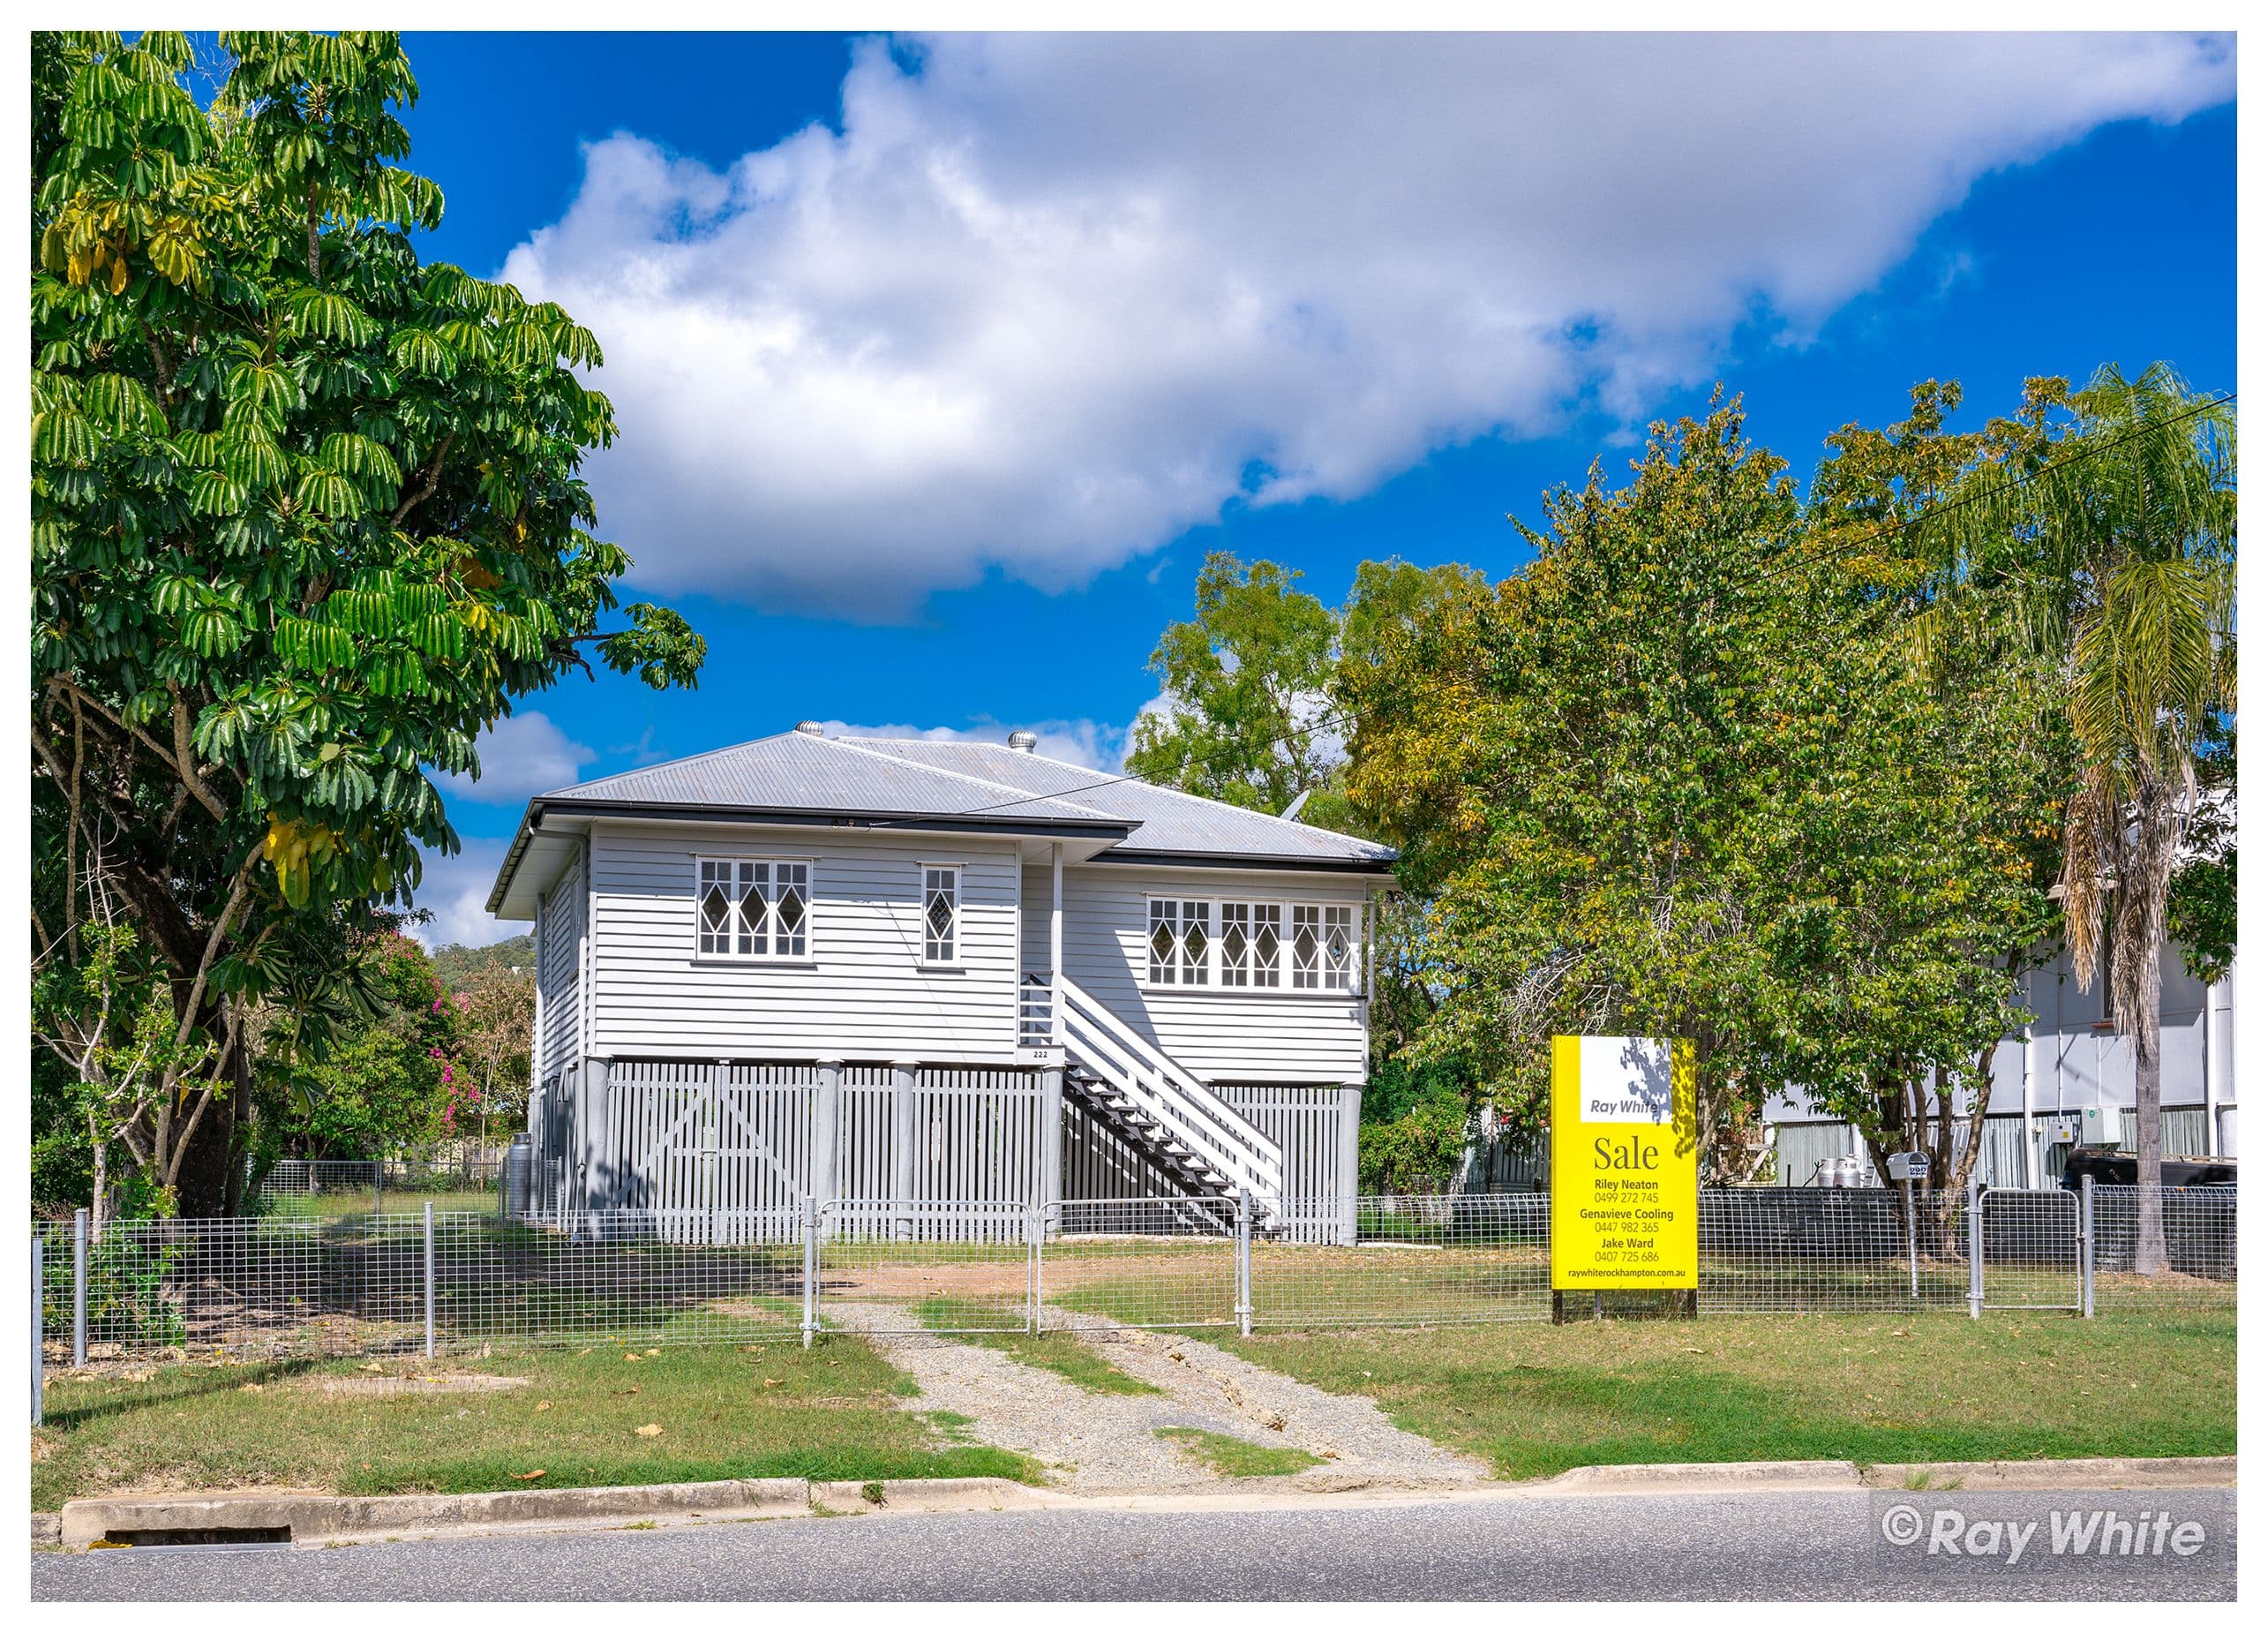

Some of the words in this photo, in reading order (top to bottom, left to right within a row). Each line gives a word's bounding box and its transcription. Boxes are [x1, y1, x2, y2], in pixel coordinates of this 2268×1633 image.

[1590, 1100, 1618, 1115] Ray
[1619, 1100, 1658, 1113] White
[1594, 1135, 1659, 1170] Sale
[1595, 1179, 1618, 1192] Riley
[1621, 1179, 1658, 1189] Neaton
[1595, 1193, 1618, 1203] 0499
[1620, 1193, 1639, 1203] 272
[1641, 1193, 1659, 1203] 745
[1580, 1208, 1632, 1219] Genavieve
[1634, 1208, 1674, 1222] Cooling
[1595, 1222, 1618, 1232] 0447
[1621, 1222, 1639, 1232] 982
[1641, 1222, 1659, 1232] 365
[1602, 1238, 1624, 1248] Jake
[1626, 1238, 1654, 1248] Ward
[1595, 1251, 1618, 1262] 0407
[1621, 1251, 1639, 1262] 725
[1641, 1251, 1659, 1262] 686
[1568, 1268, 1686, 1278] raywhiterockhampton.com.au
